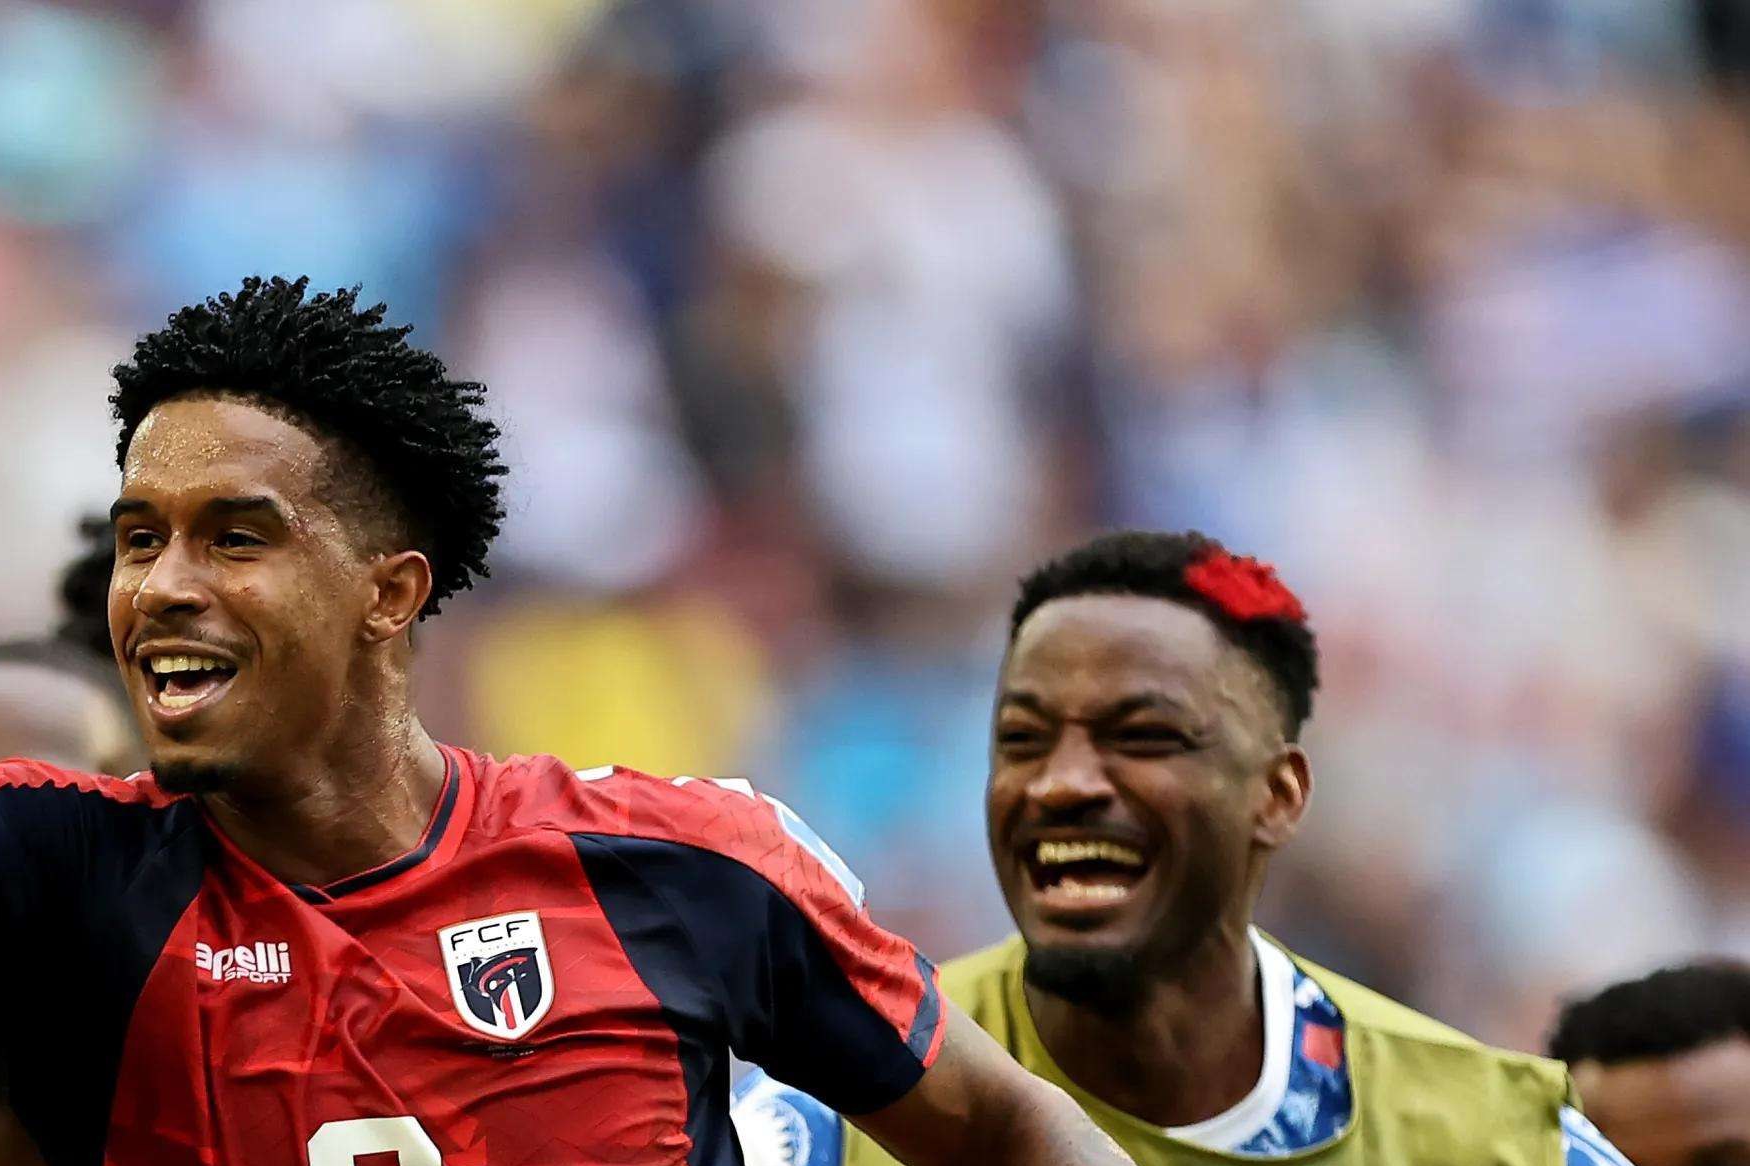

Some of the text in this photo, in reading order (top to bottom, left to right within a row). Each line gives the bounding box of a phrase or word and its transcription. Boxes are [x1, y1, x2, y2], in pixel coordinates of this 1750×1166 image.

[450, 919, 530, 951] FCF
[195, 941, 291, 980] apelli
[224, 966, 292, 984] SPORT
